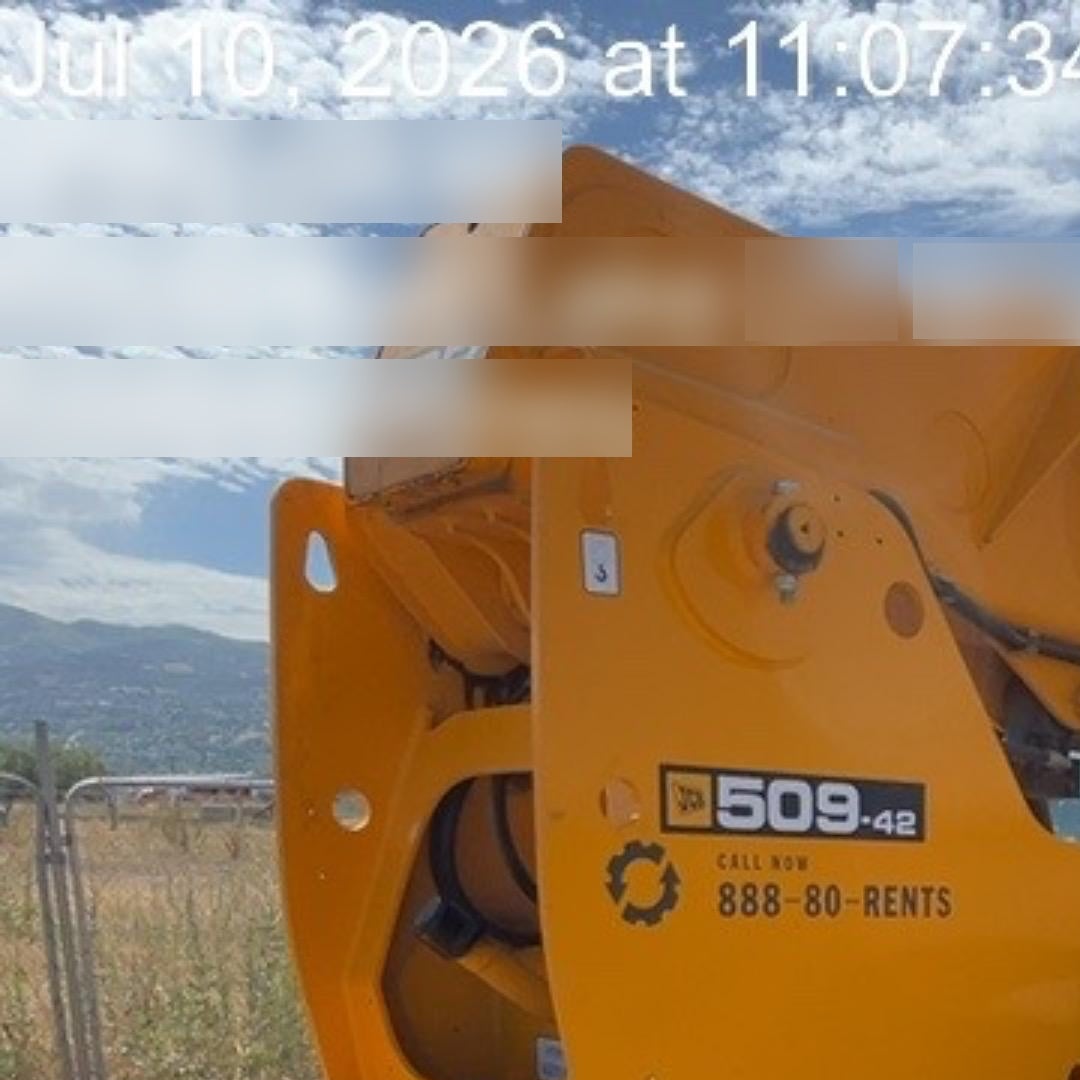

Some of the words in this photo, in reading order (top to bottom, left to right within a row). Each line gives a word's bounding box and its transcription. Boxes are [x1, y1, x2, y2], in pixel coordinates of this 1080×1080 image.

[717, 853, 762, 871] CALL
[771, 855, 809, 871] NOW
[718, 881, 953, 919] 888-80-RENTS
